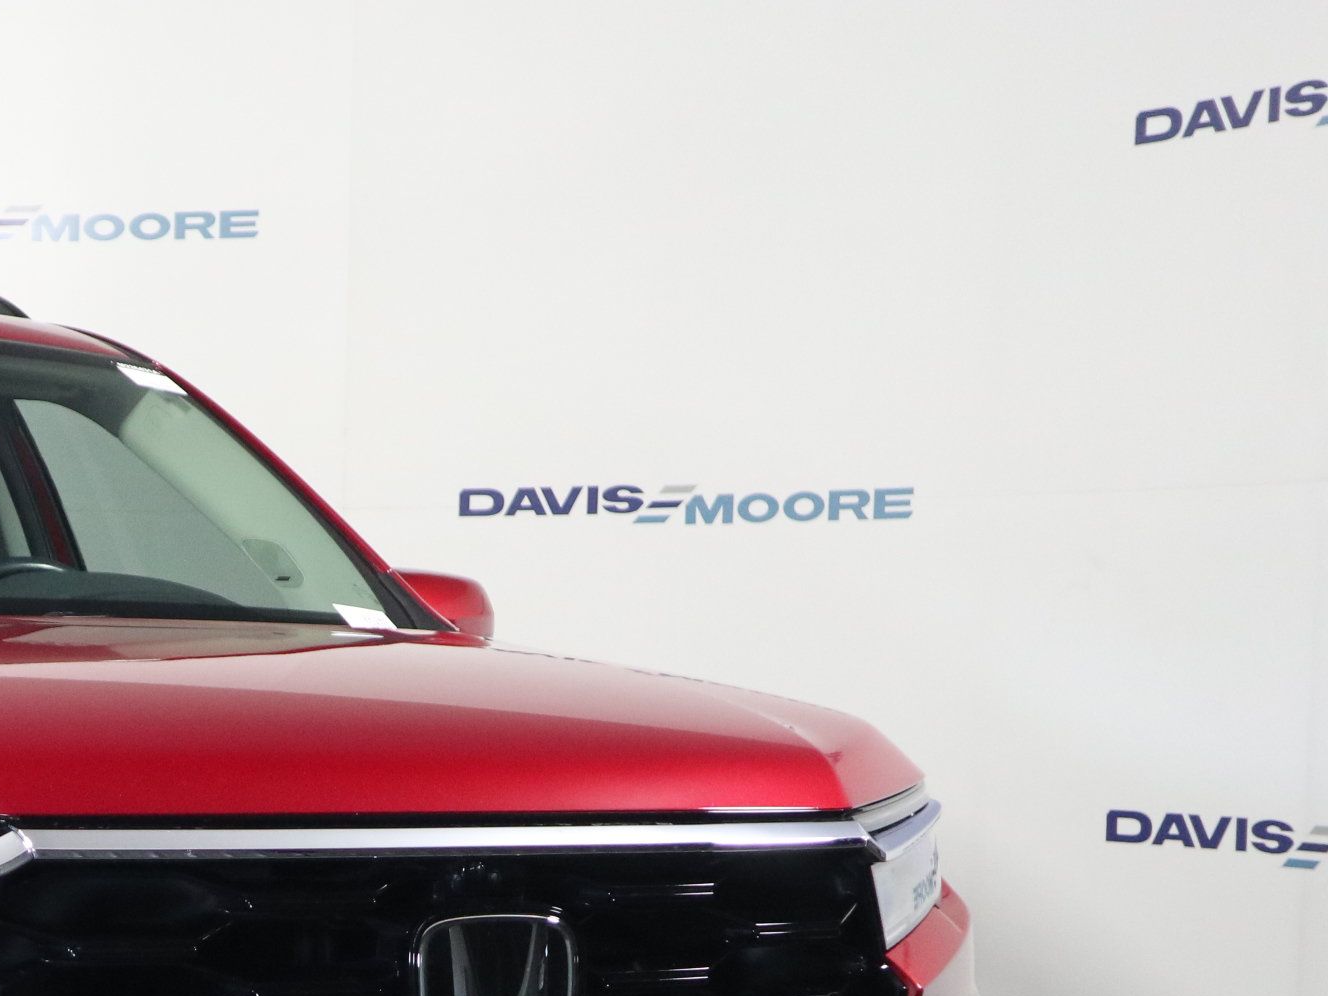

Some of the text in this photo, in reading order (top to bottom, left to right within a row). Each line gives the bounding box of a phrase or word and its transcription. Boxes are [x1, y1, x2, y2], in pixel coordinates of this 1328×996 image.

[1134, 79, 1328, 145] DAVIS
[31, 209, 260, 242] MOORE
[458, 484, 915, 525] DAVIS MOORE
[1105, 809, 1295, 854] DAVIS
